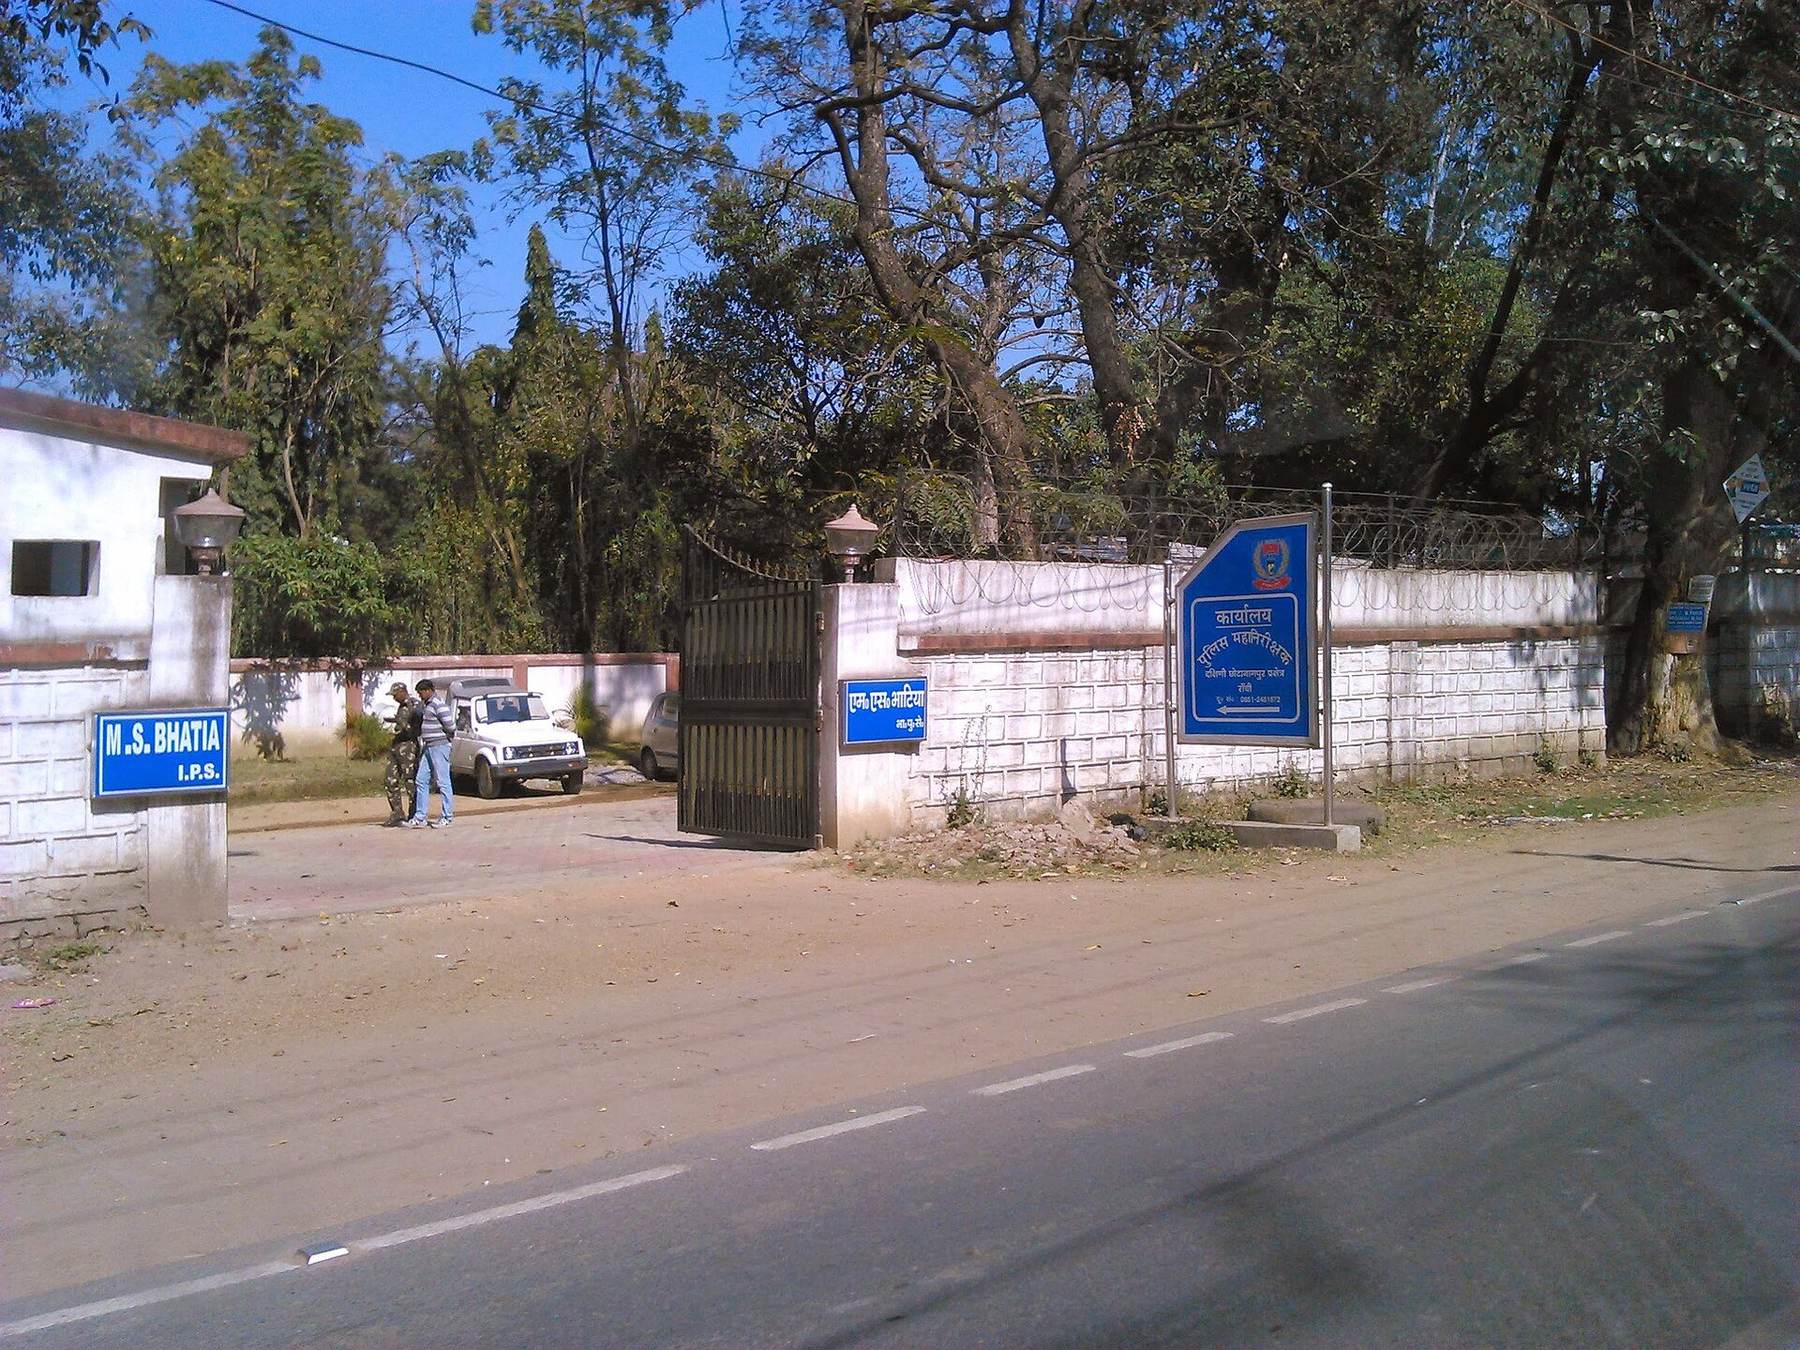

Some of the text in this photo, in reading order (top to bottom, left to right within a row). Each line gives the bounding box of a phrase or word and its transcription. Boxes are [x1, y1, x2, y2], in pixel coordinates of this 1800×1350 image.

[1215, 604, 1272, 625] कार्यालय
[1197, 628, 1293, 668] पुलिस महानिरीक्षक
[891, 683, 925, 709] भाटिया
[154, 719, 220, 754] BHATIA
[178, 762, 220, 782] I.P.S.
